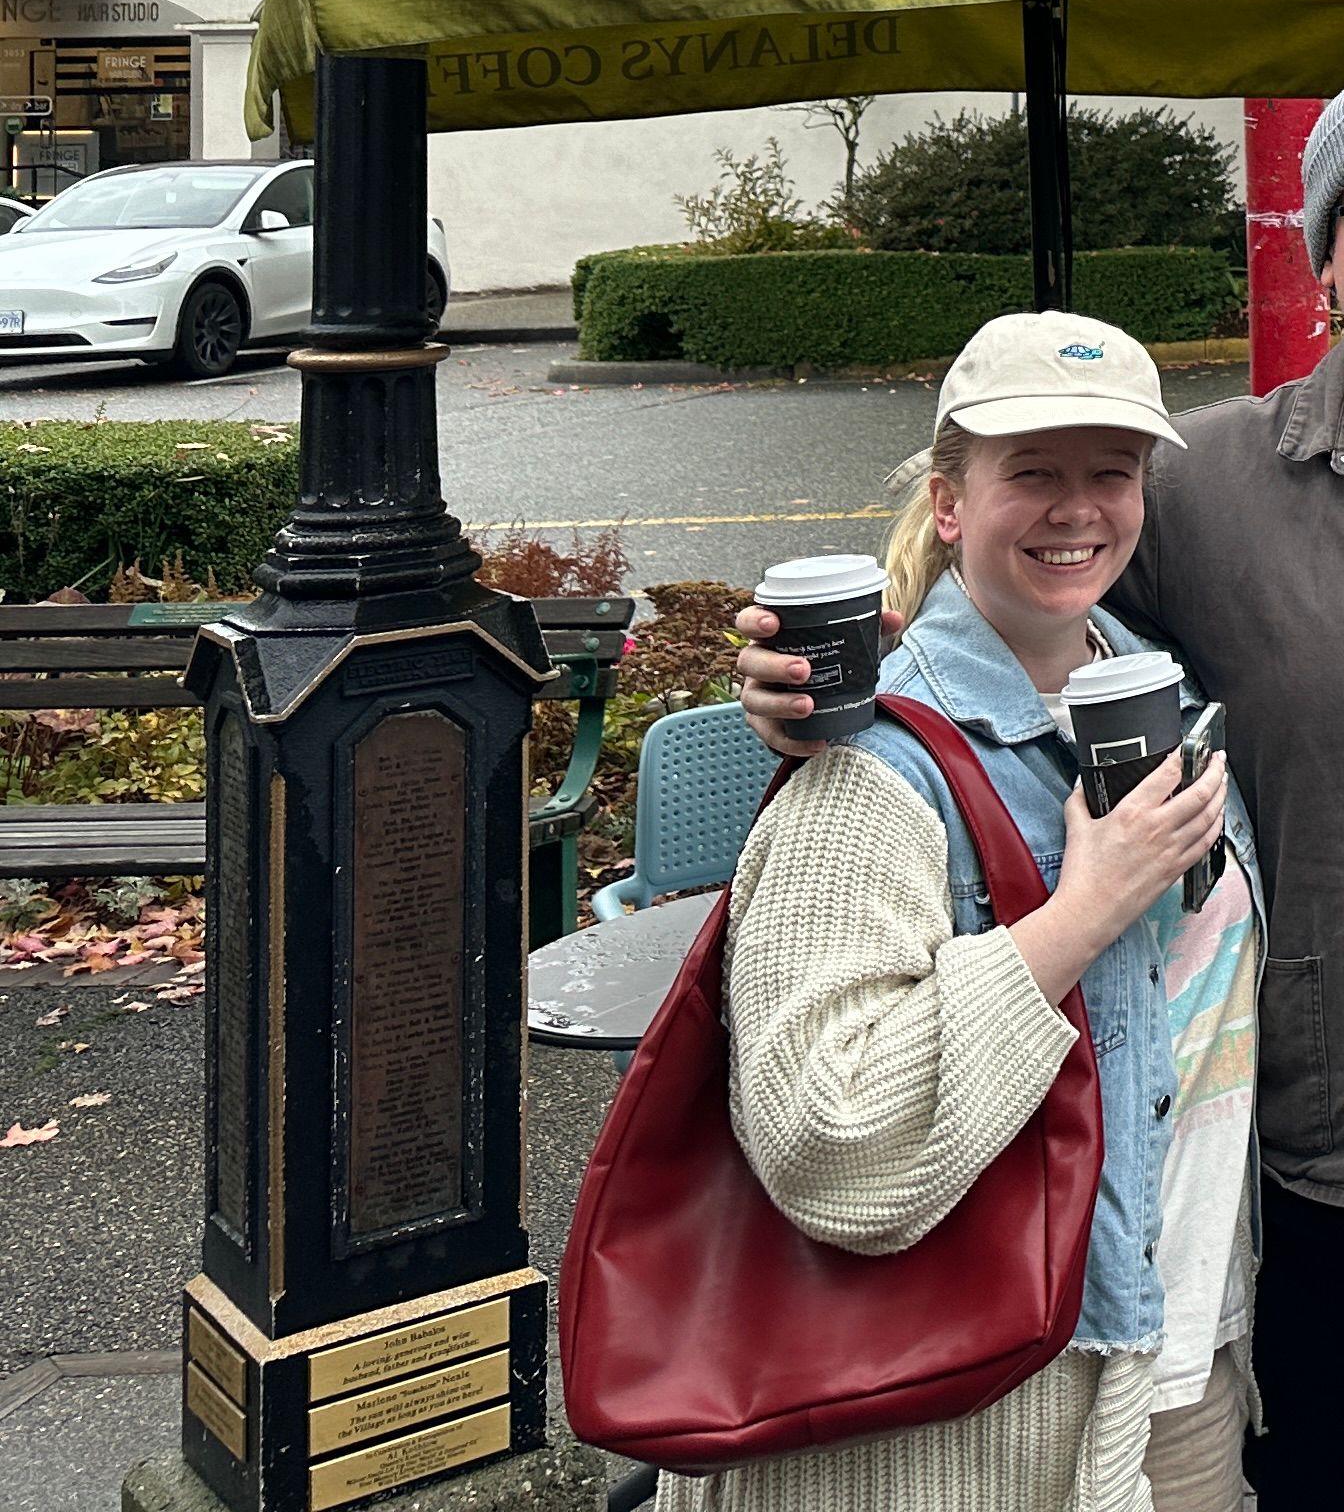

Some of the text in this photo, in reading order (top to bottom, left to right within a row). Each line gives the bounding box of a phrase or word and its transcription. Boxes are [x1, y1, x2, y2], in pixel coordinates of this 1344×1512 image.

[77, 2, 109, 22] HAIR
[112, 2, 160, 22] STUDIO
[104, 55, 147, 69] FRINGE
[39, 149, 80, 161] FRINGE
